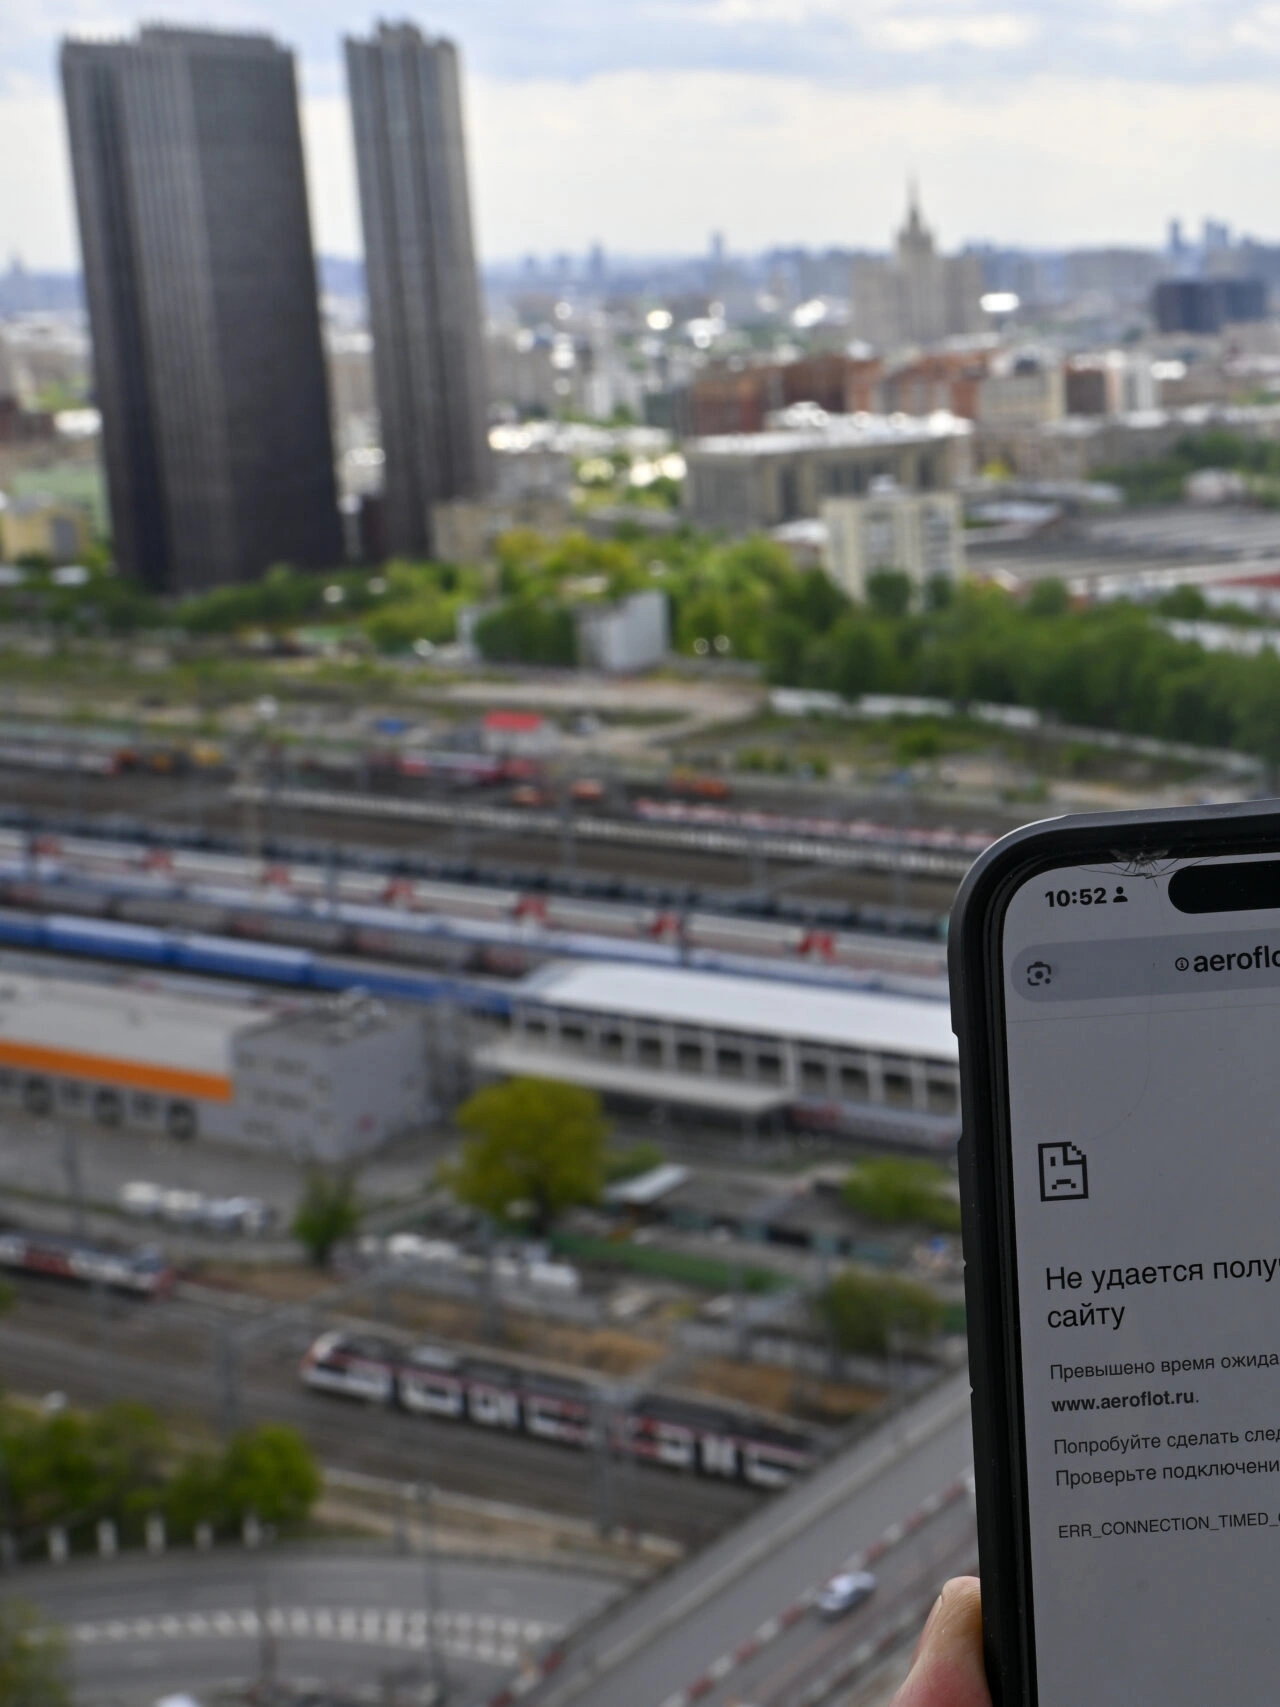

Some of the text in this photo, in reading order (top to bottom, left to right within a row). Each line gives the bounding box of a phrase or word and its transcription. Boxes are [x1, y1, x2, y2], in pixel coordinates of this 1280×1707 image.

[1045, 887, 1107, 907] 10:52
[1046, 1266, 1082, 1290] Не
[1091, 1263, 1203, 1294] удается
[1048, 1302, 1125, 1330] сайту
[1050, 1362, 1155, 1383] Превышено
[1161, 1358, 1214, 1376] время
[1051, 1391, 1199, 1412] www.aeroflot.ru.
[1054, 1434, 1161, 1456] Попробуйте
[1167, 1432, 1239, 1449] сделать
[1056, 1468, 1157, 1489] Проверьте
